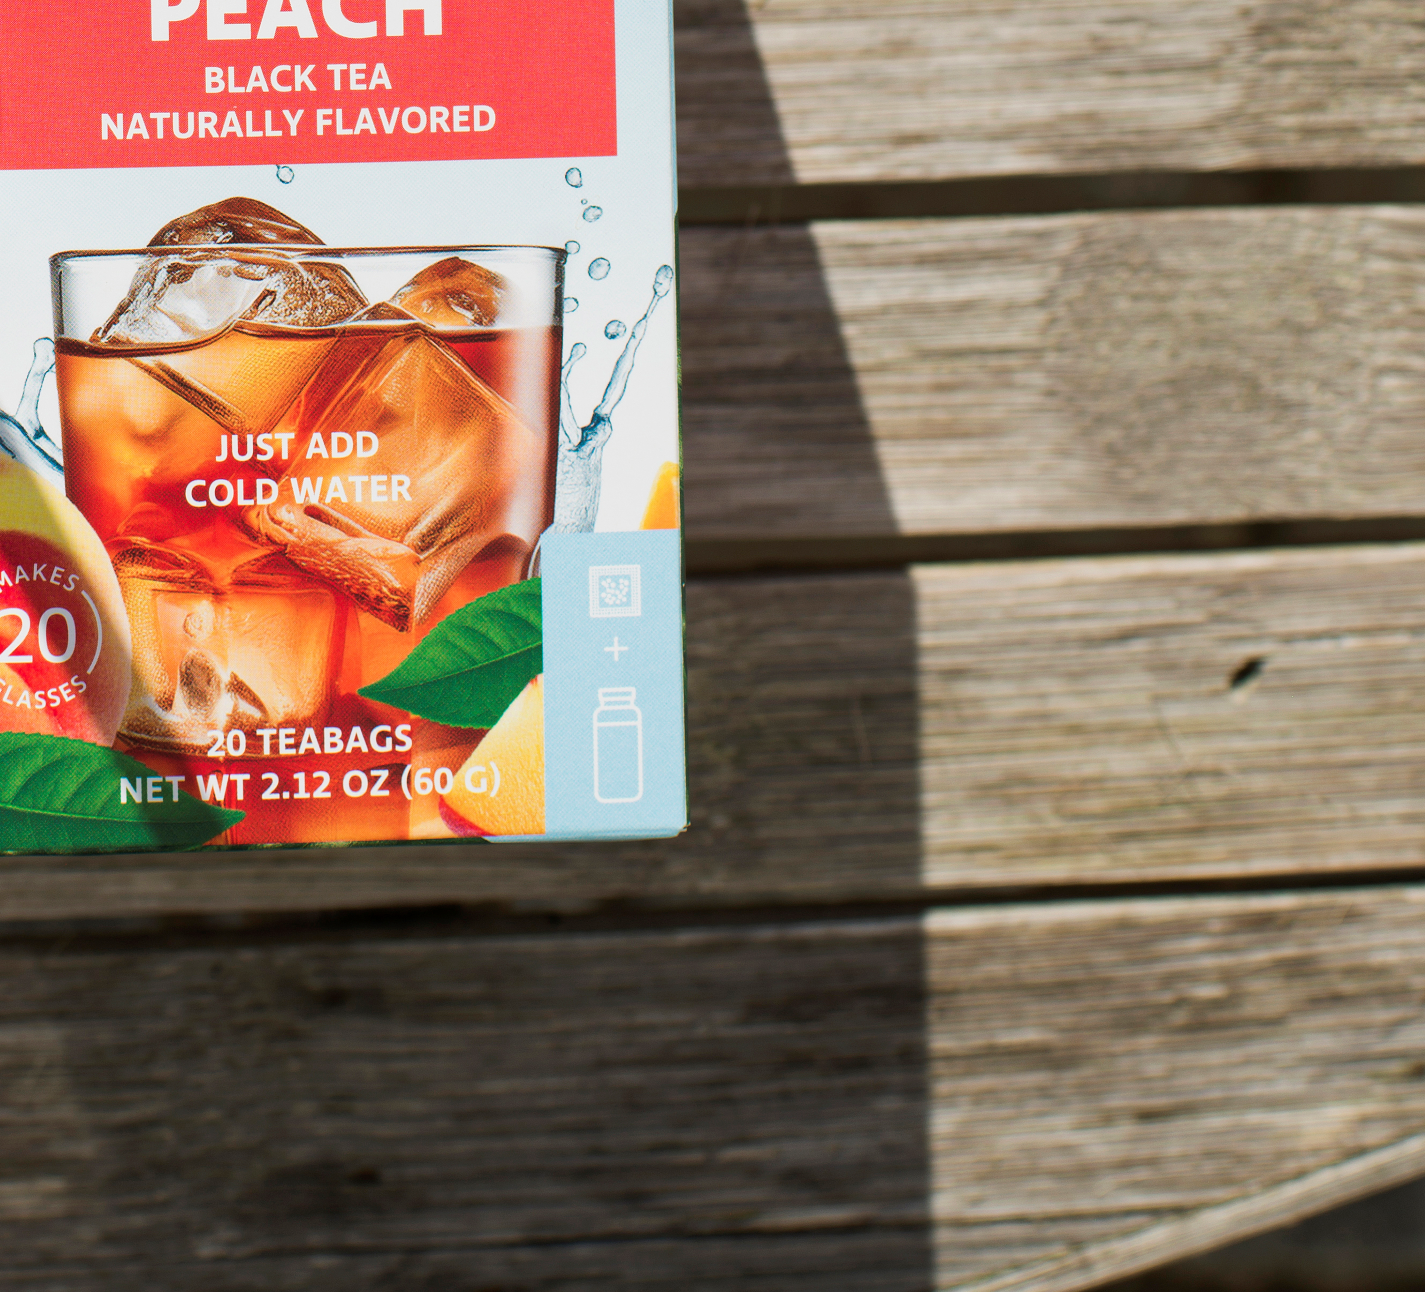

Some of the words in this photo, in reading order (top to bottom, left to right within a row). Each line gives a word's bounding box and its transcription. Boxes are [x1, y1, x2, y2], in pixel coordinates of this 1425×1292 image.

[205, 65, 316, 93] BLACK
[327, 63, 392, 90] TEA
[102, 110, 304, 139] NATURALLY
[317, 105, 495, 135] FLAVORED
[216, 433, 294, 461] JUST
[306, 431, 378, 458] ADD
[186, 479, 278, 506] COLD
[291, 474, 412, 504] WATER
[206, 727, 247, 757] 20
[257, 725, 412, 754] TEABAGS
[121, 775, 186, 803] NET
[197, 774, 250, 800] WT
[262, 771, 331, 798] 2.12
[343, 770, 389, 796] OZ
[400, 765, 454, 799] (60
[465, 761, 500, 797] G)
